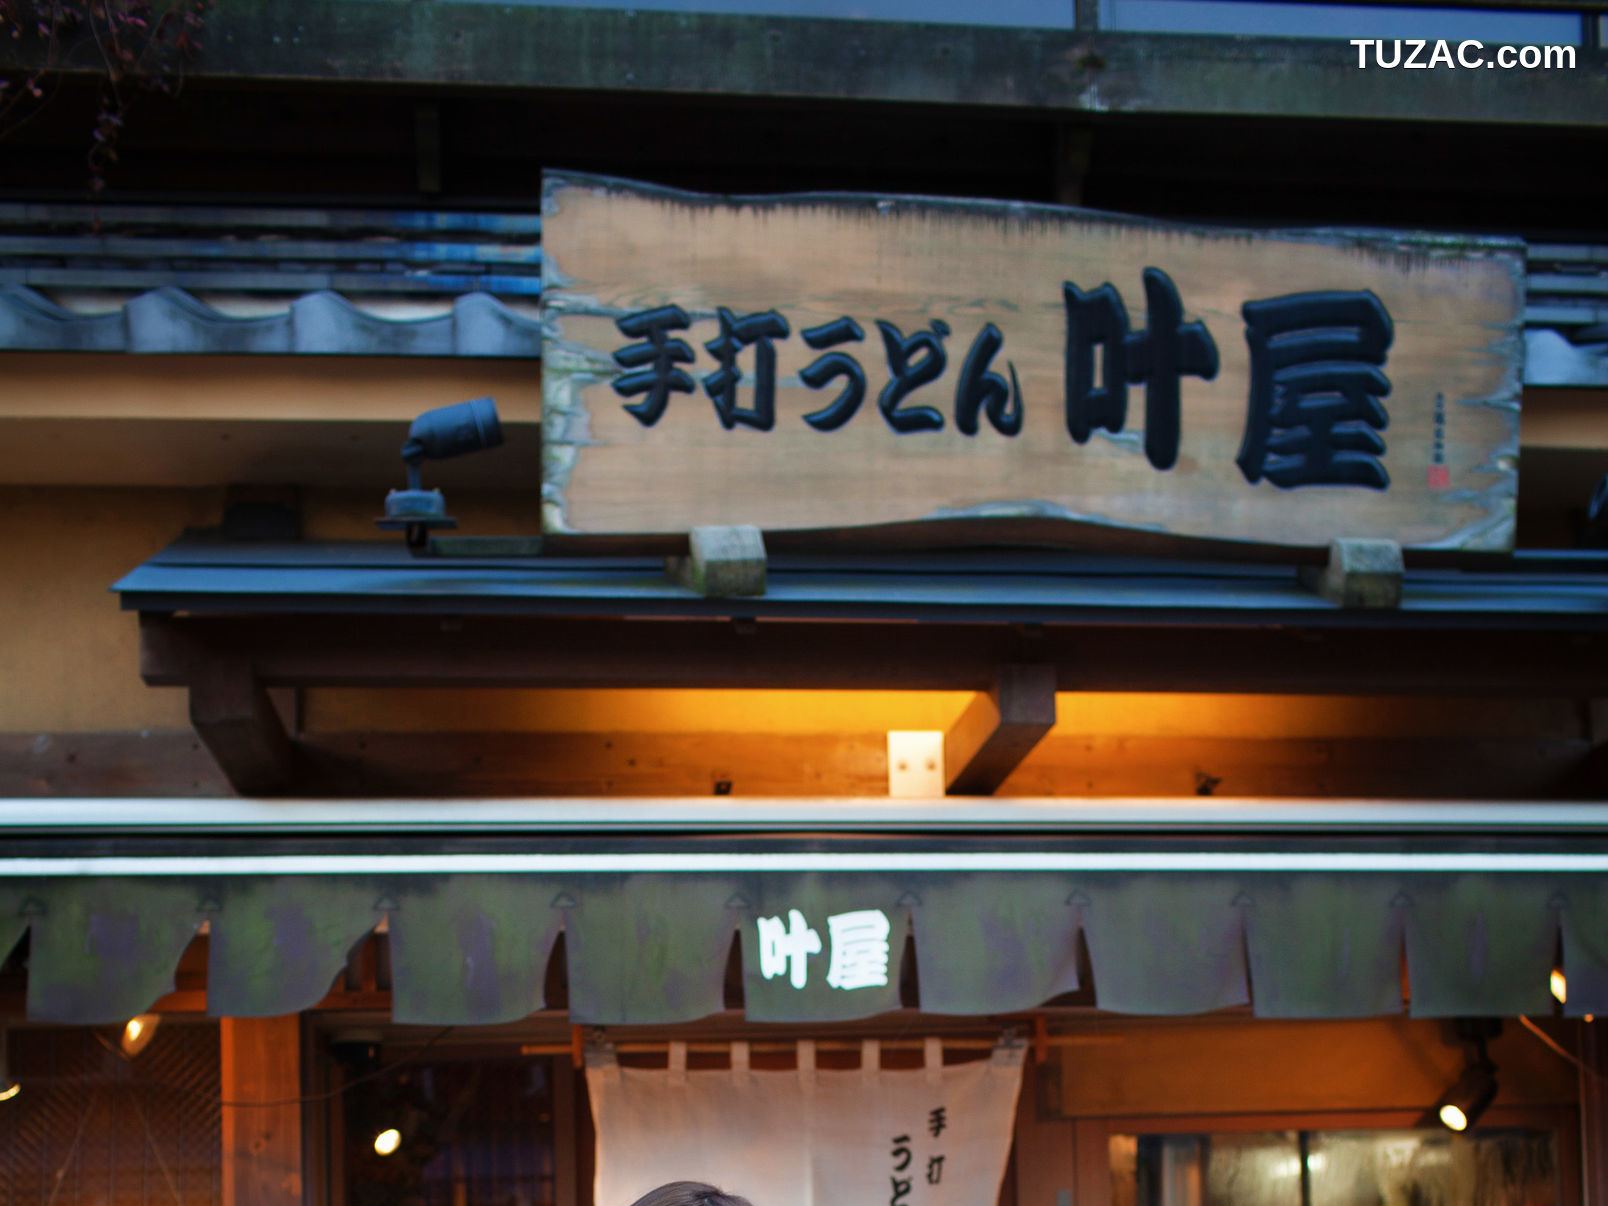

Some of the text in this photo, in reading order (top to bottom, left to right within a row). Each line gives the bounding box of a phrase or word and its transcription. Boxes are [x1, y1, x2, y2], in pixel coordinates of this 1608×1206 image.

[612, 303, 1024, 436] 手打うどん
[1063, 267, 1395, 490] 叶屋
[756, 908, 891, 991] 叶屋
[926, 1106, 947, 1185] 手打
